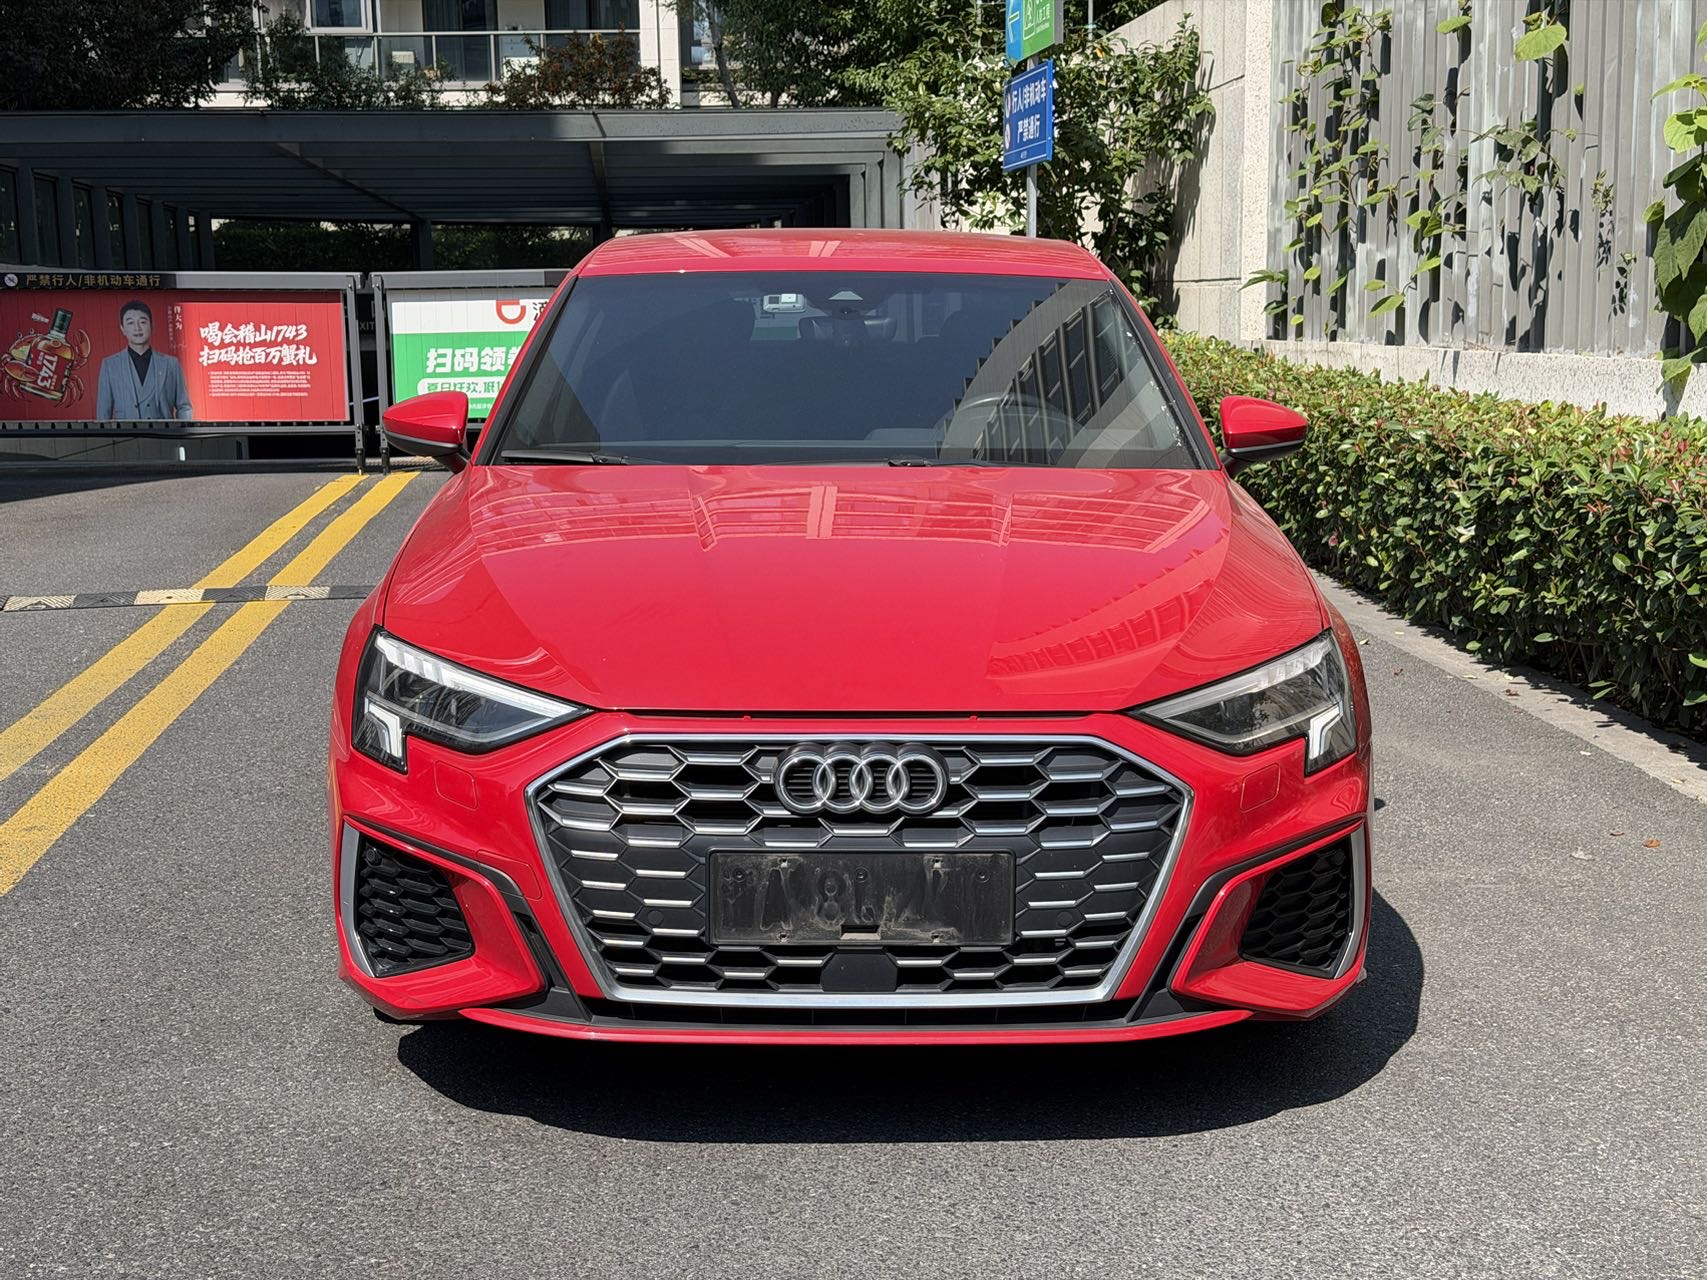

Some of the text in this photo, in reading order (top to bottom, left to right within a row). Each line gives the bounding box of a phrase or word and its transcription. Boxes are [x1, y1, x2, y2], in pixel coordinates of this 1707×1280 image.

[1017, 114, 1041, 144] 严禁通行
[26, 274, 161, 287] 严禁行人/非机动车通行
[199, 321, 308, 346] 喝会稽山1743
[359, 321, 374, 331] XIT
[199, 343, 318, 366] 扫码抢百万蟹礼
